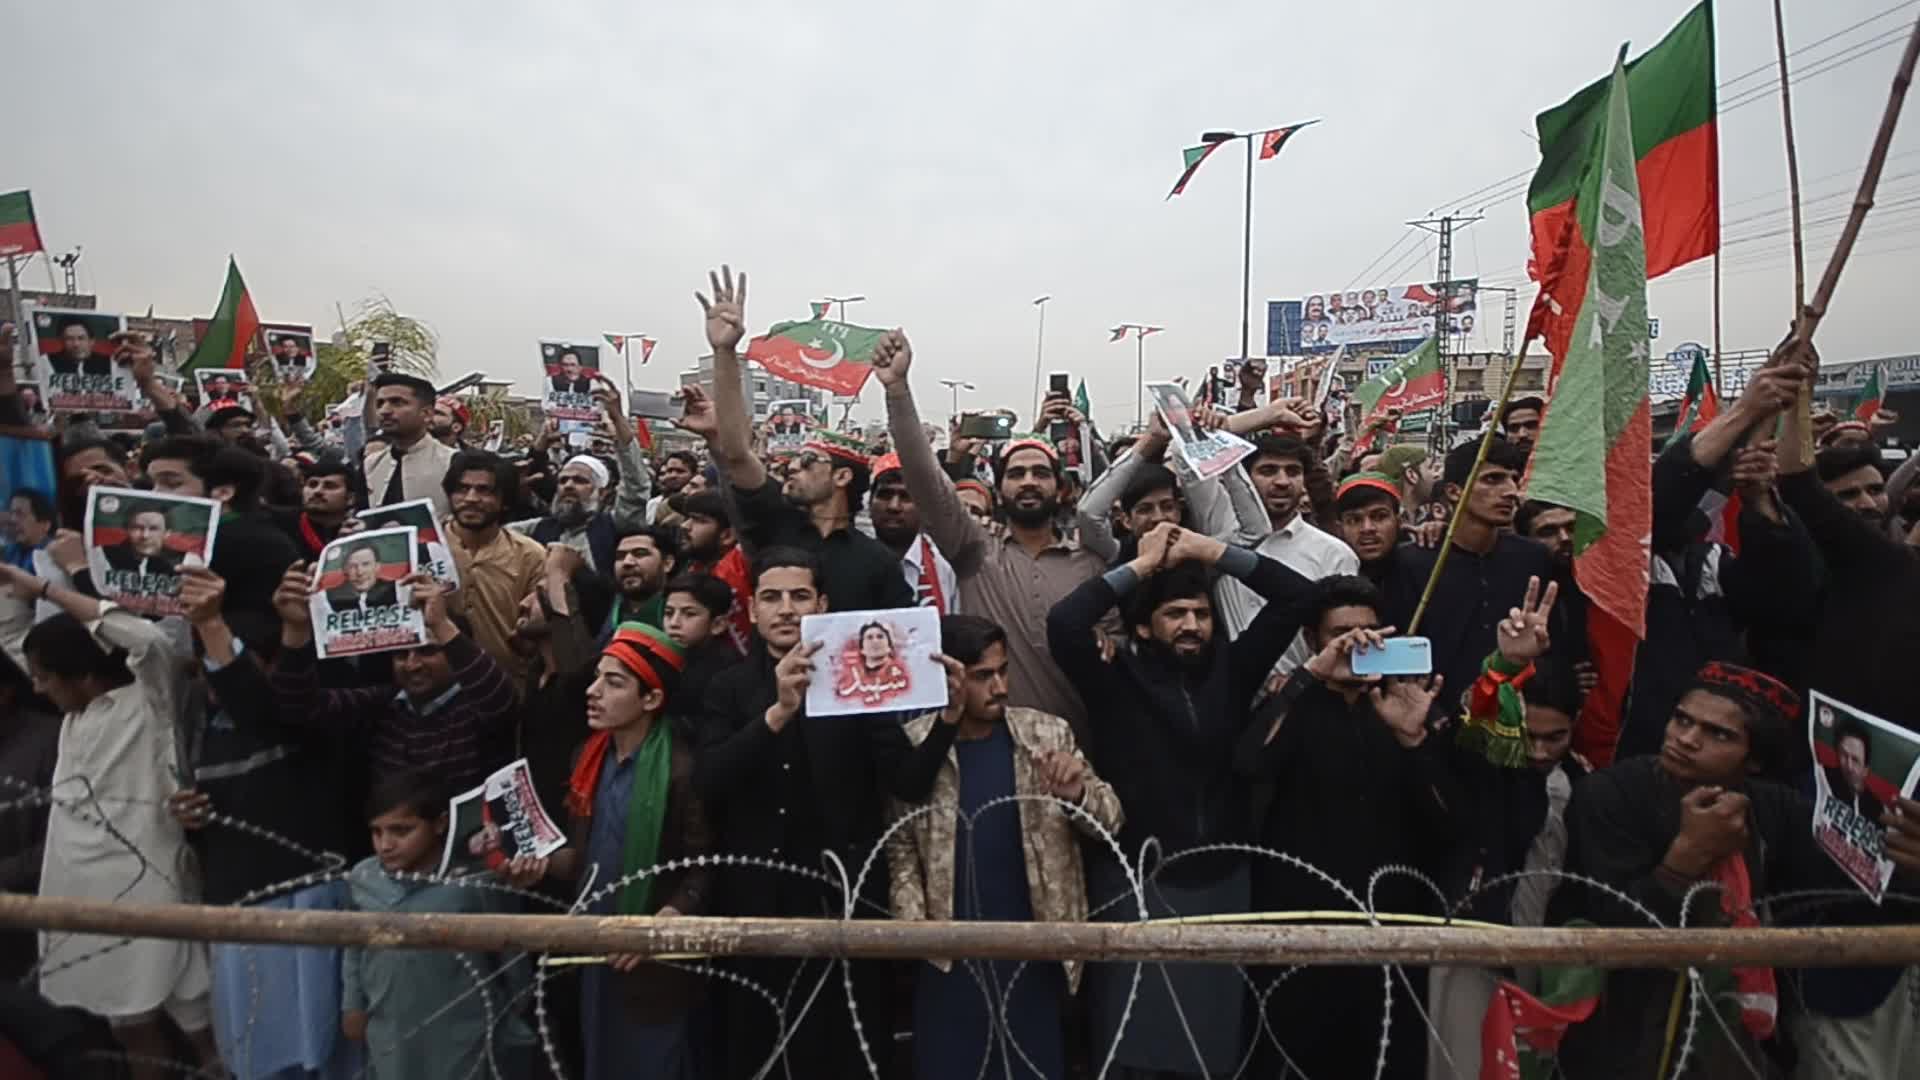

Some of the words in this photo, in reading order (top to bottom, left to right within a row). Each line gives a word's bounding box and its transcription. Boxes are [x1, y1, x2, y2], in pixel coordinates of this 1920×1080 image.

[326, 604, 413, 631] RELEASE
[500, 780, 537, 855] RELEASE
[1823, 796, 1890, 853] RELEAS
